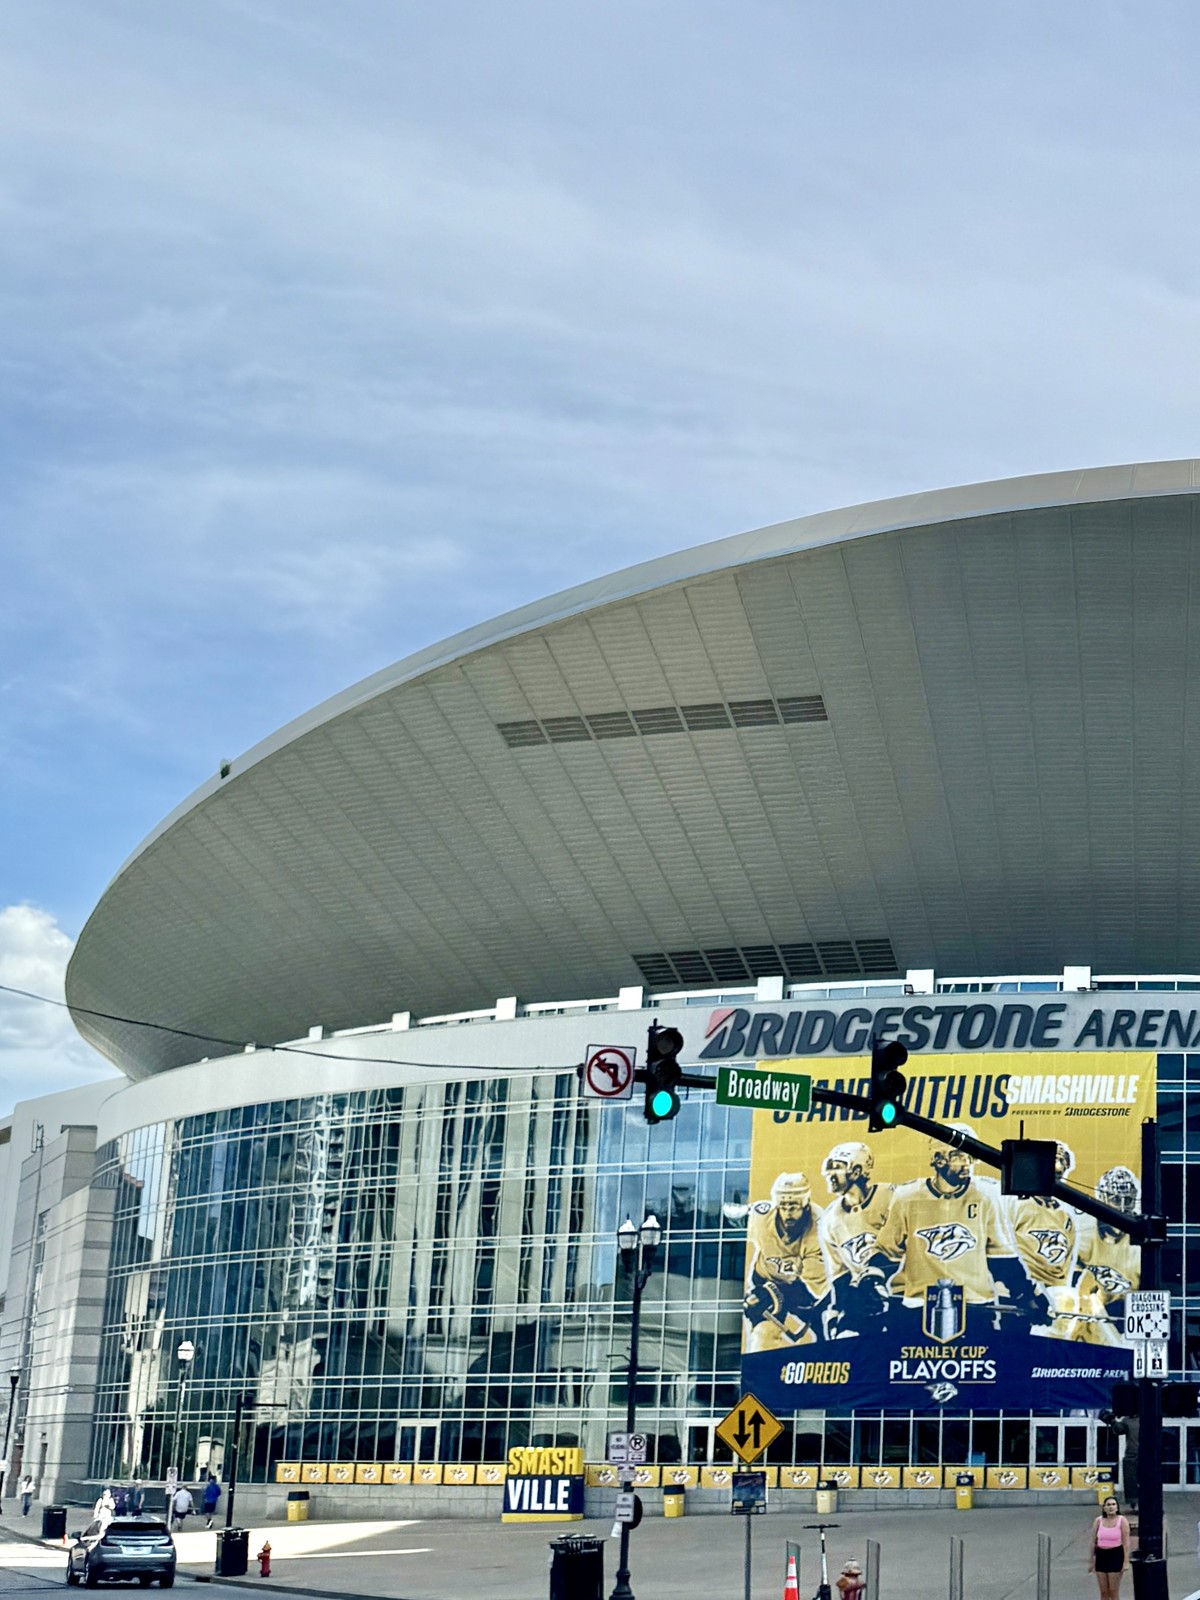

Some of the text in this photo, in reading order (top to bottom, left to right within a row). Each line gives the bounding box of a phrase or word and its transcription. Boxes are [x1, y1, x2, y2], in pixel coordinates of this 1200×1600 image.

[698, 1003, 1067, 1059] BRIDGESTONE
[727, 1070, 800, 1109] Broadway
[969, 1074, 1012, 1118] US
[1006, 1074, 1140, 1104] SMASHVILLE
[1065, 1107, 1131, 1116] BRIDGESTONE
[1131, 1293, 1165, 1302] DIAGONAL
[1131, 1303, 1165, 1312] CROSSING
[1127, 1316, 1144, 1333] OK
[901, 1346, 958, 1359] STANLEY
[780, 1361, 851, 1384] #GOPREDS
[889, 1360, 997, 1380] PLAYOFFS
[1031, 1367, 1102, 1378] BRIDGESTONE
[508, 1447, 582, 1475] SMASH
[507, 1479, 571, 1511] VILLE
